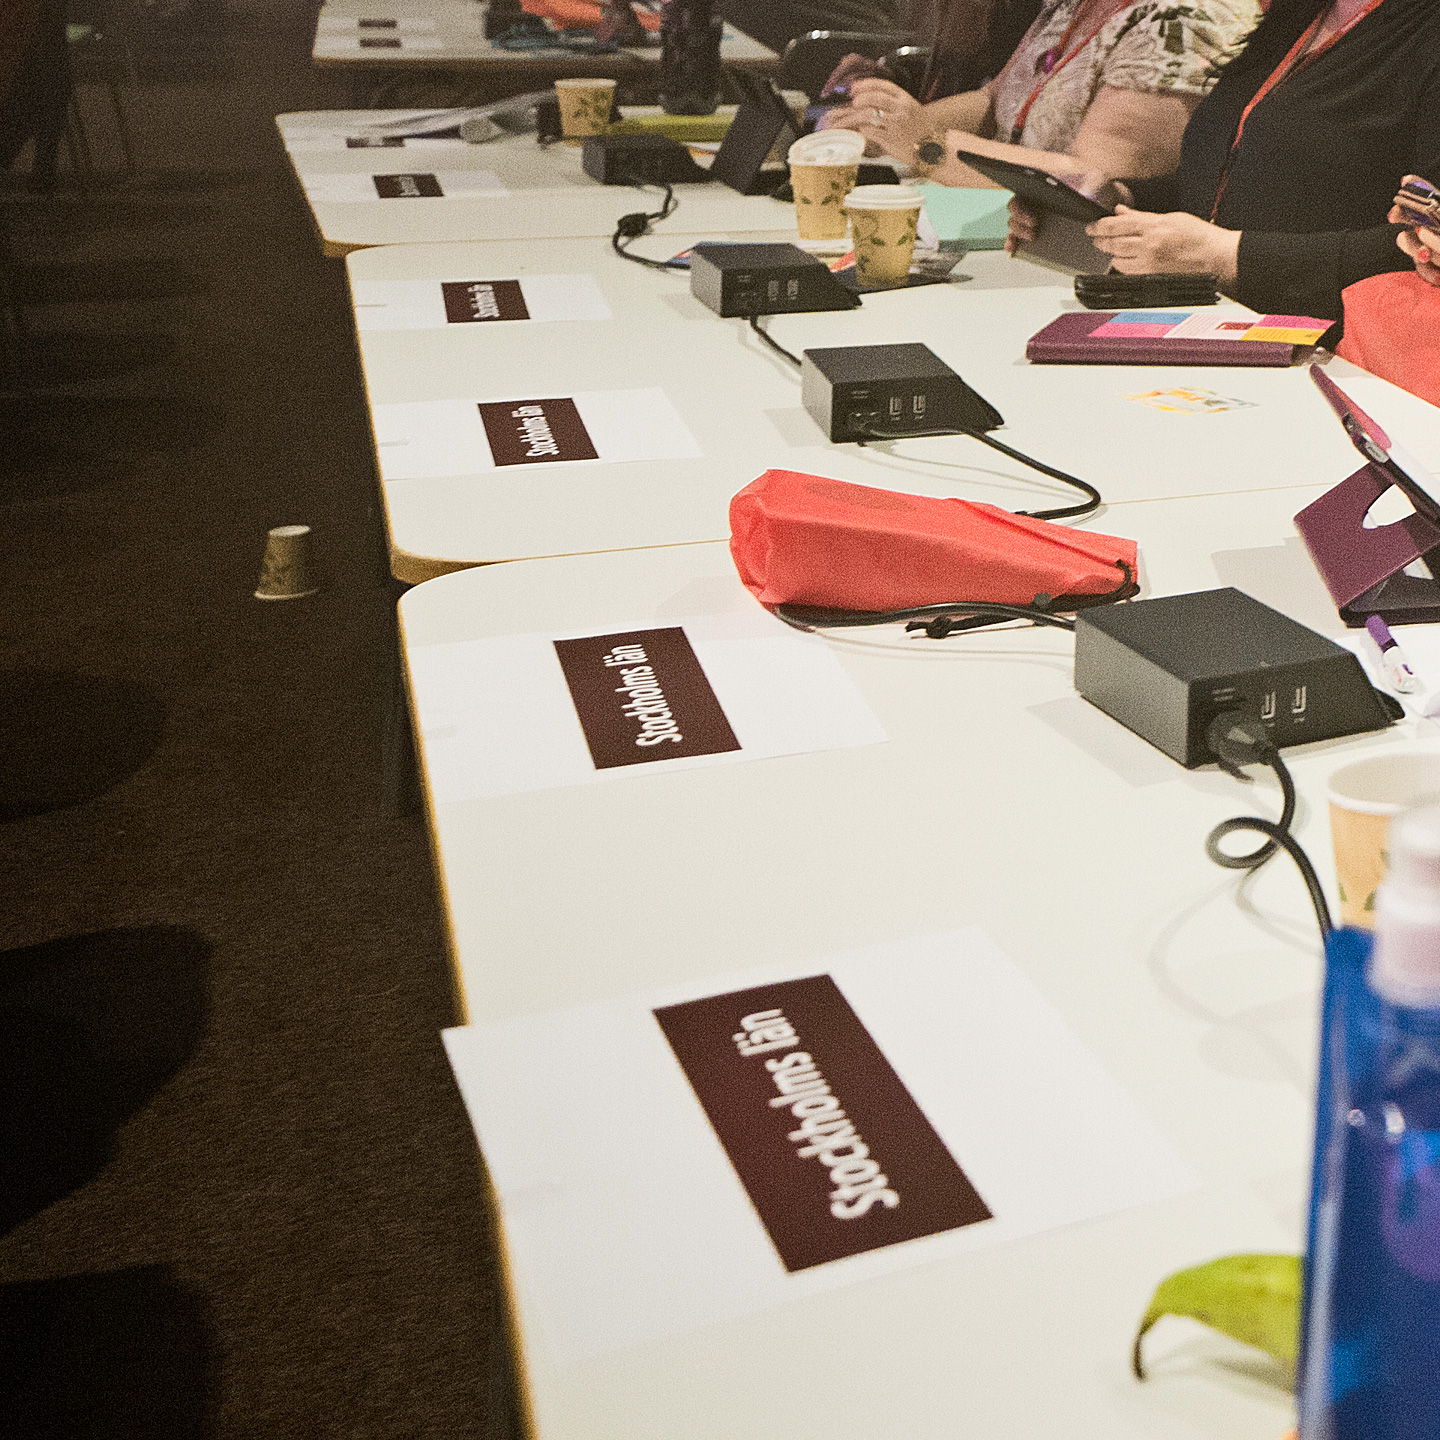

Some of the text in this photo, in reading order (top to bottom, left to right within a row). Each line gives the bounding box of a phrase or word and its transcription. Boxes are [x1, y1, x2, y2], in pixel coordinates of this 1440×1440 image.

[602, 644, 683, 746] Stockholms län
[732, 1008, 900, 1219] Stockholms län
